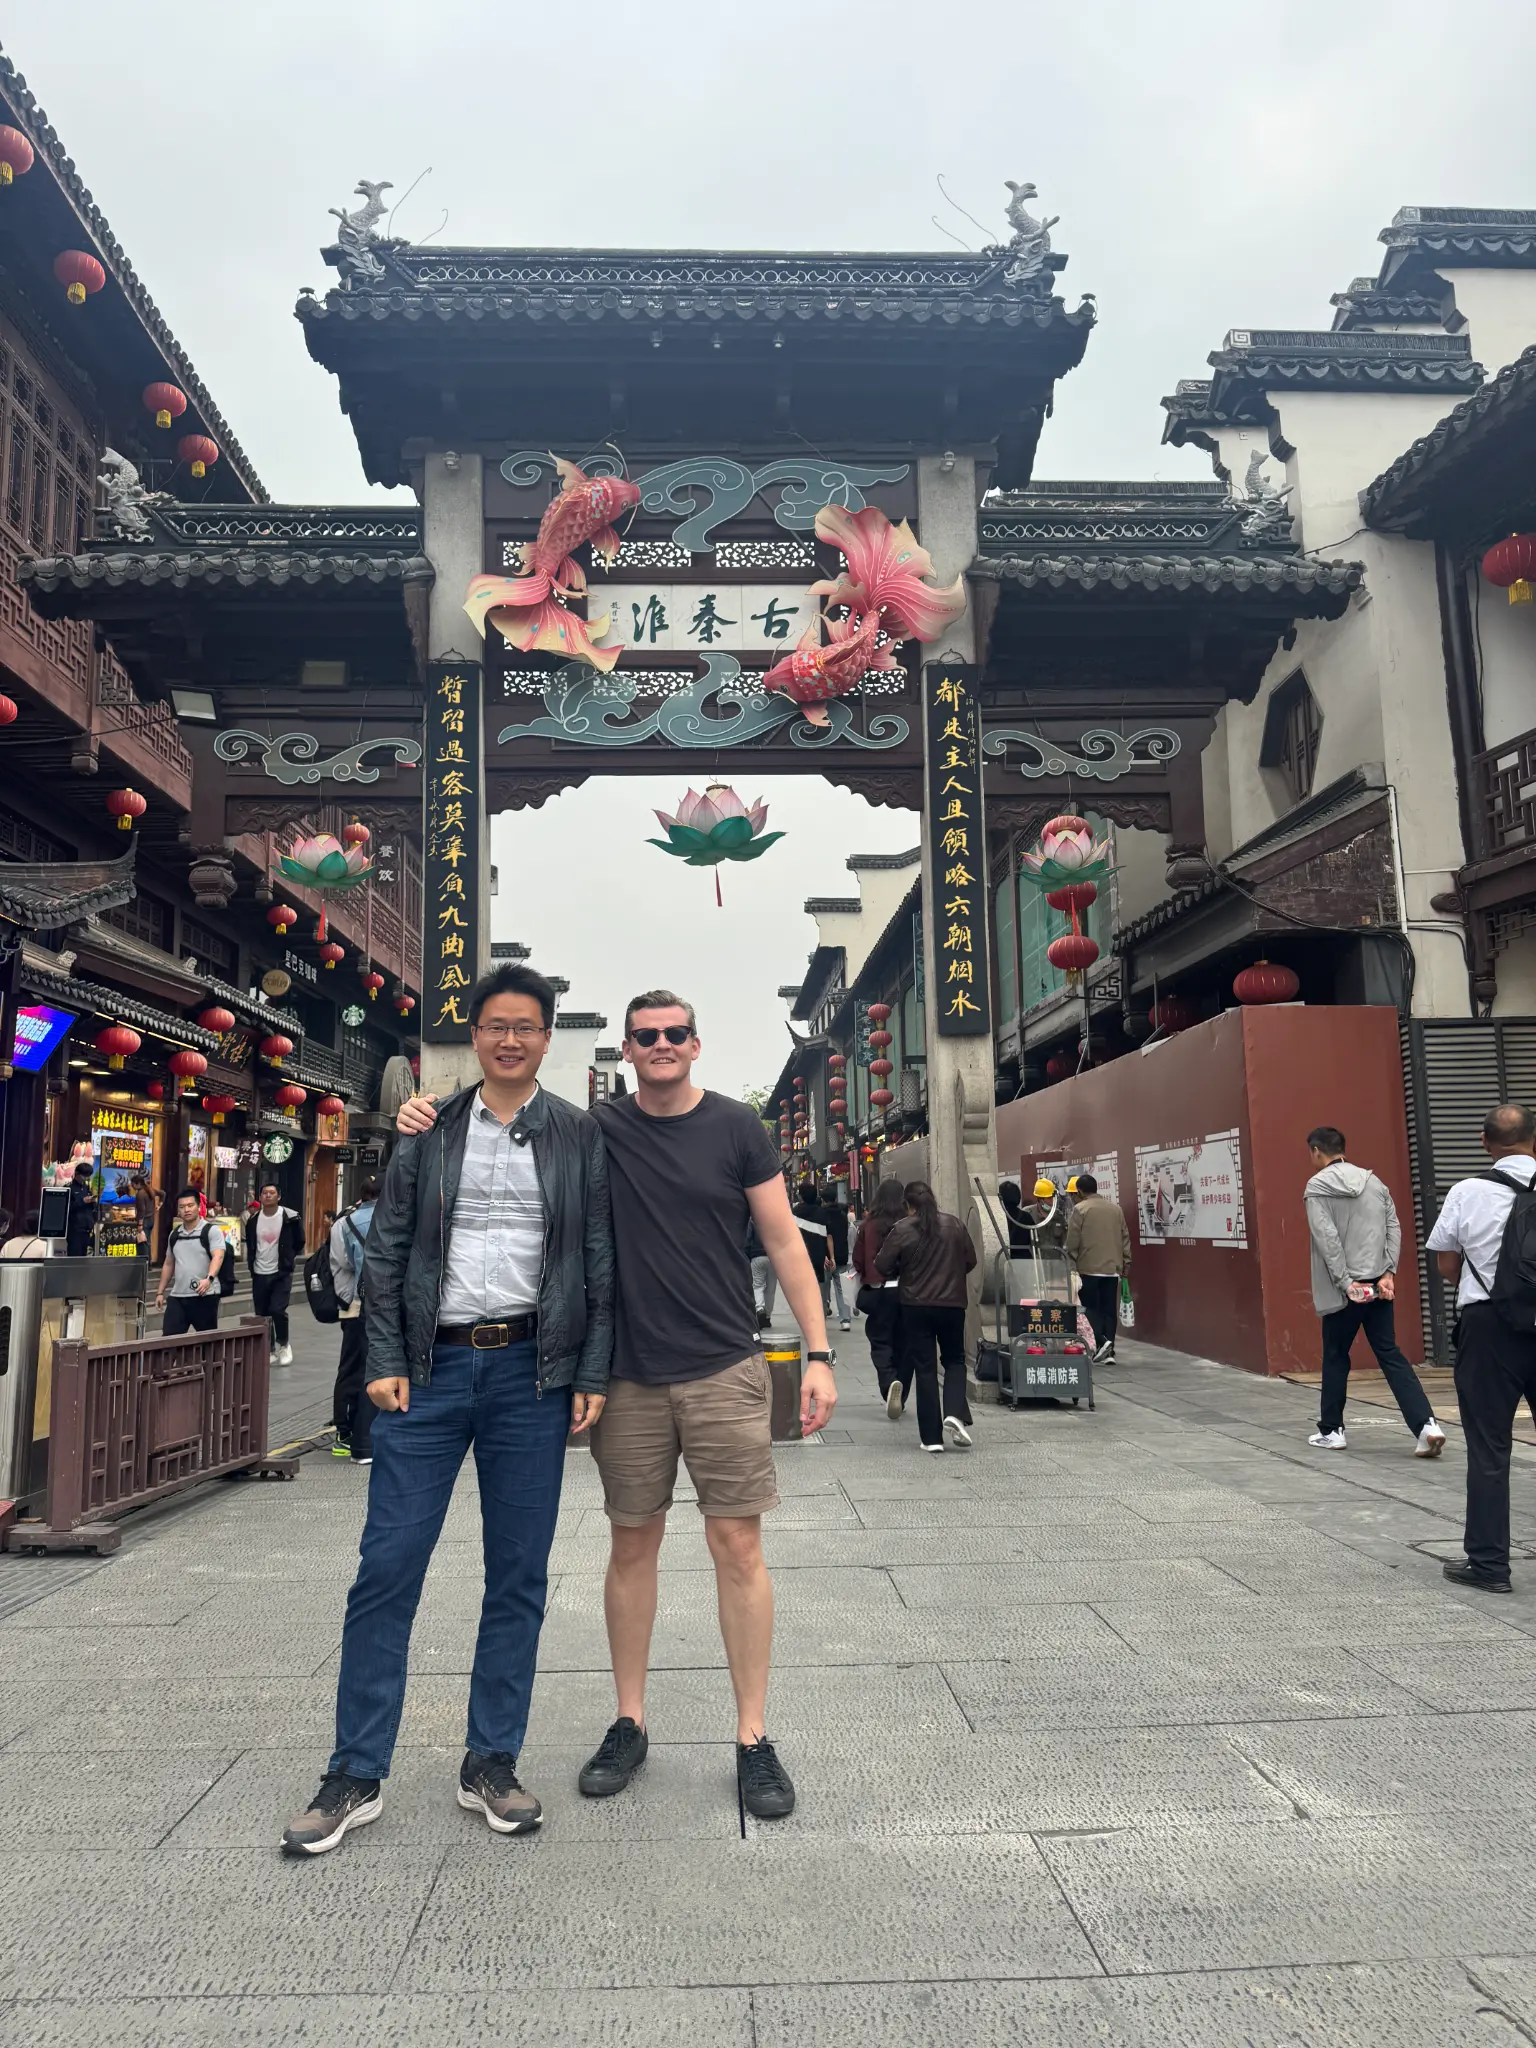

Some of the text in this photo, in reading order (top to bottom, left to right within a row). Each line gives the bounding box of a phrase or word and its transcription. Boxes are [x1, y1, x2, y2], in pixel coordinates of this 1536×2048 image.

[631, 594, 799, 644] 古秦淮
[1030, 1308, 1062, 1322] 警察
[1028, 1323, 1064, 1333] POLICE
[1026, 1366, 1079, 1385] 防爆消防架
